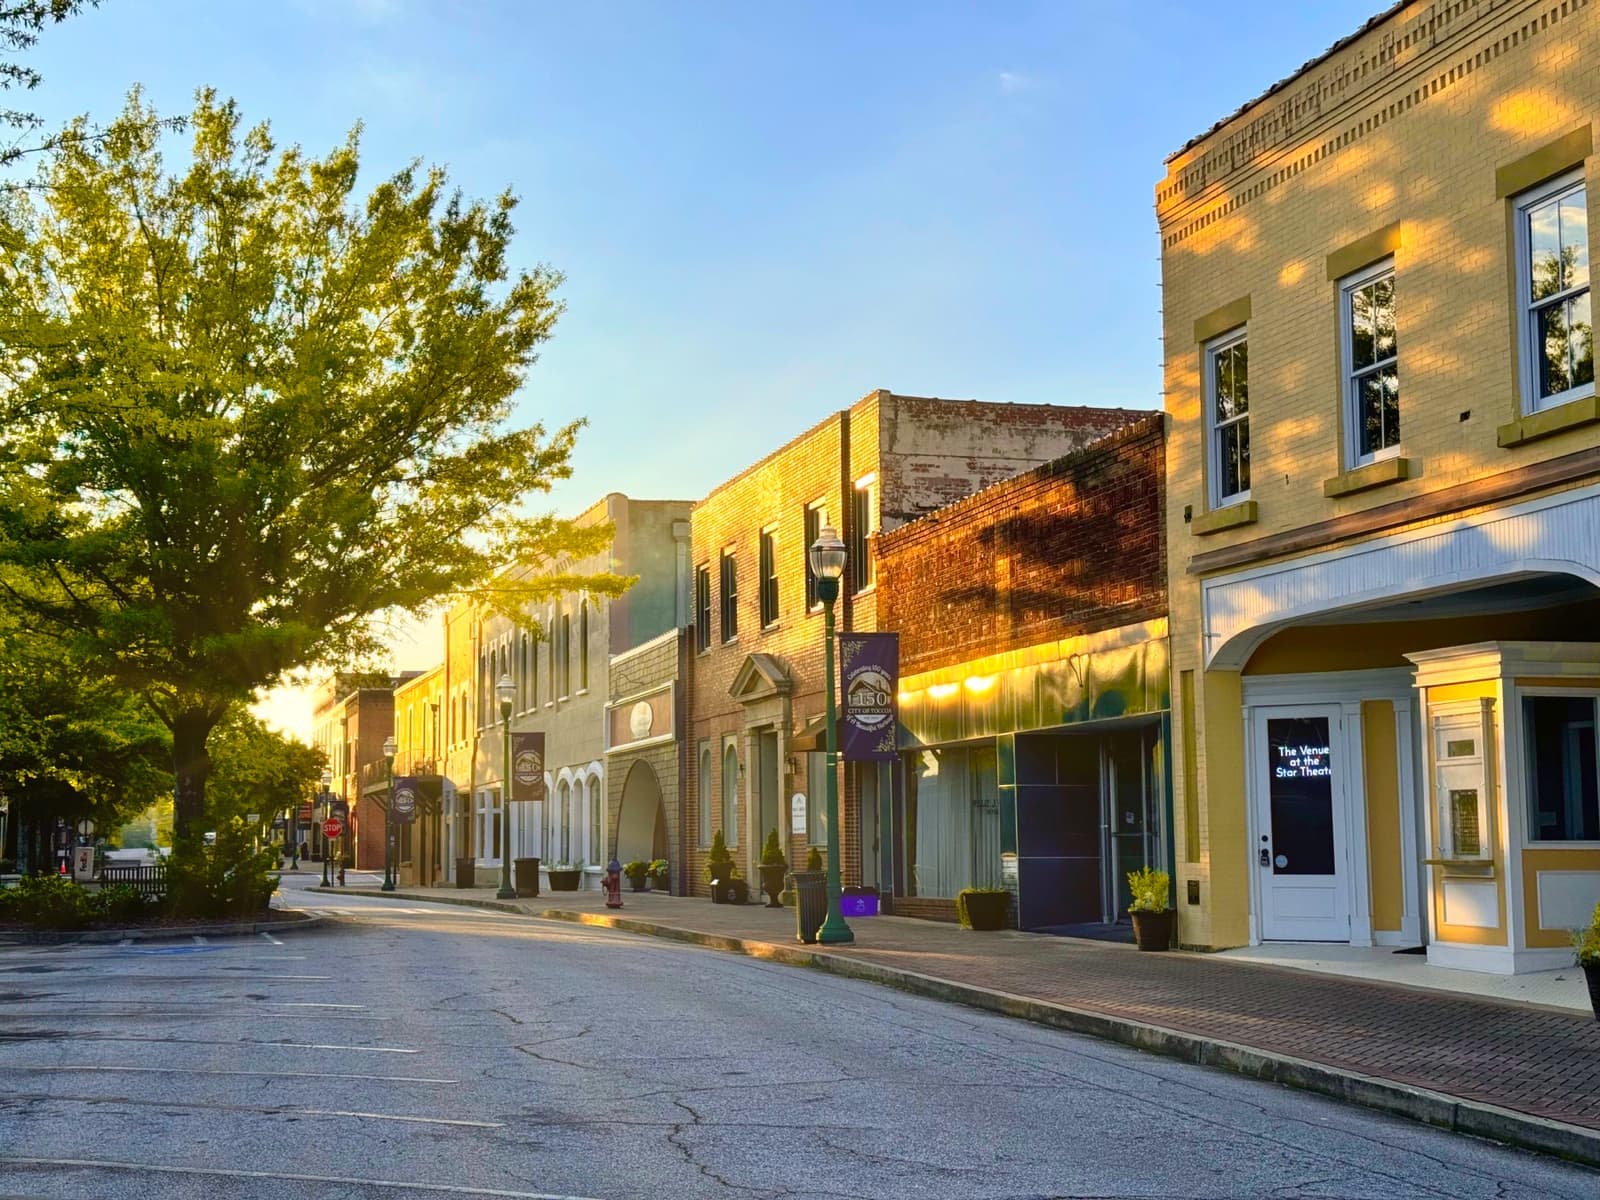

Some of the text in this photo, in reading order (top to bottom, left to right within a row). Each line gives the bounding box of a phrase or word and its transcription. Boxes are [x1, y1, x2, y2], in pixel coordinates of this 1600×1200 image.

[857, 692, 887, 706] 150
[1278, 744, 1330, 757] The Venue
[1290, 755, 1320, 767] at the
[1276, 766, 1297, 778] Star
[324, 824, 341, 832] STOP
